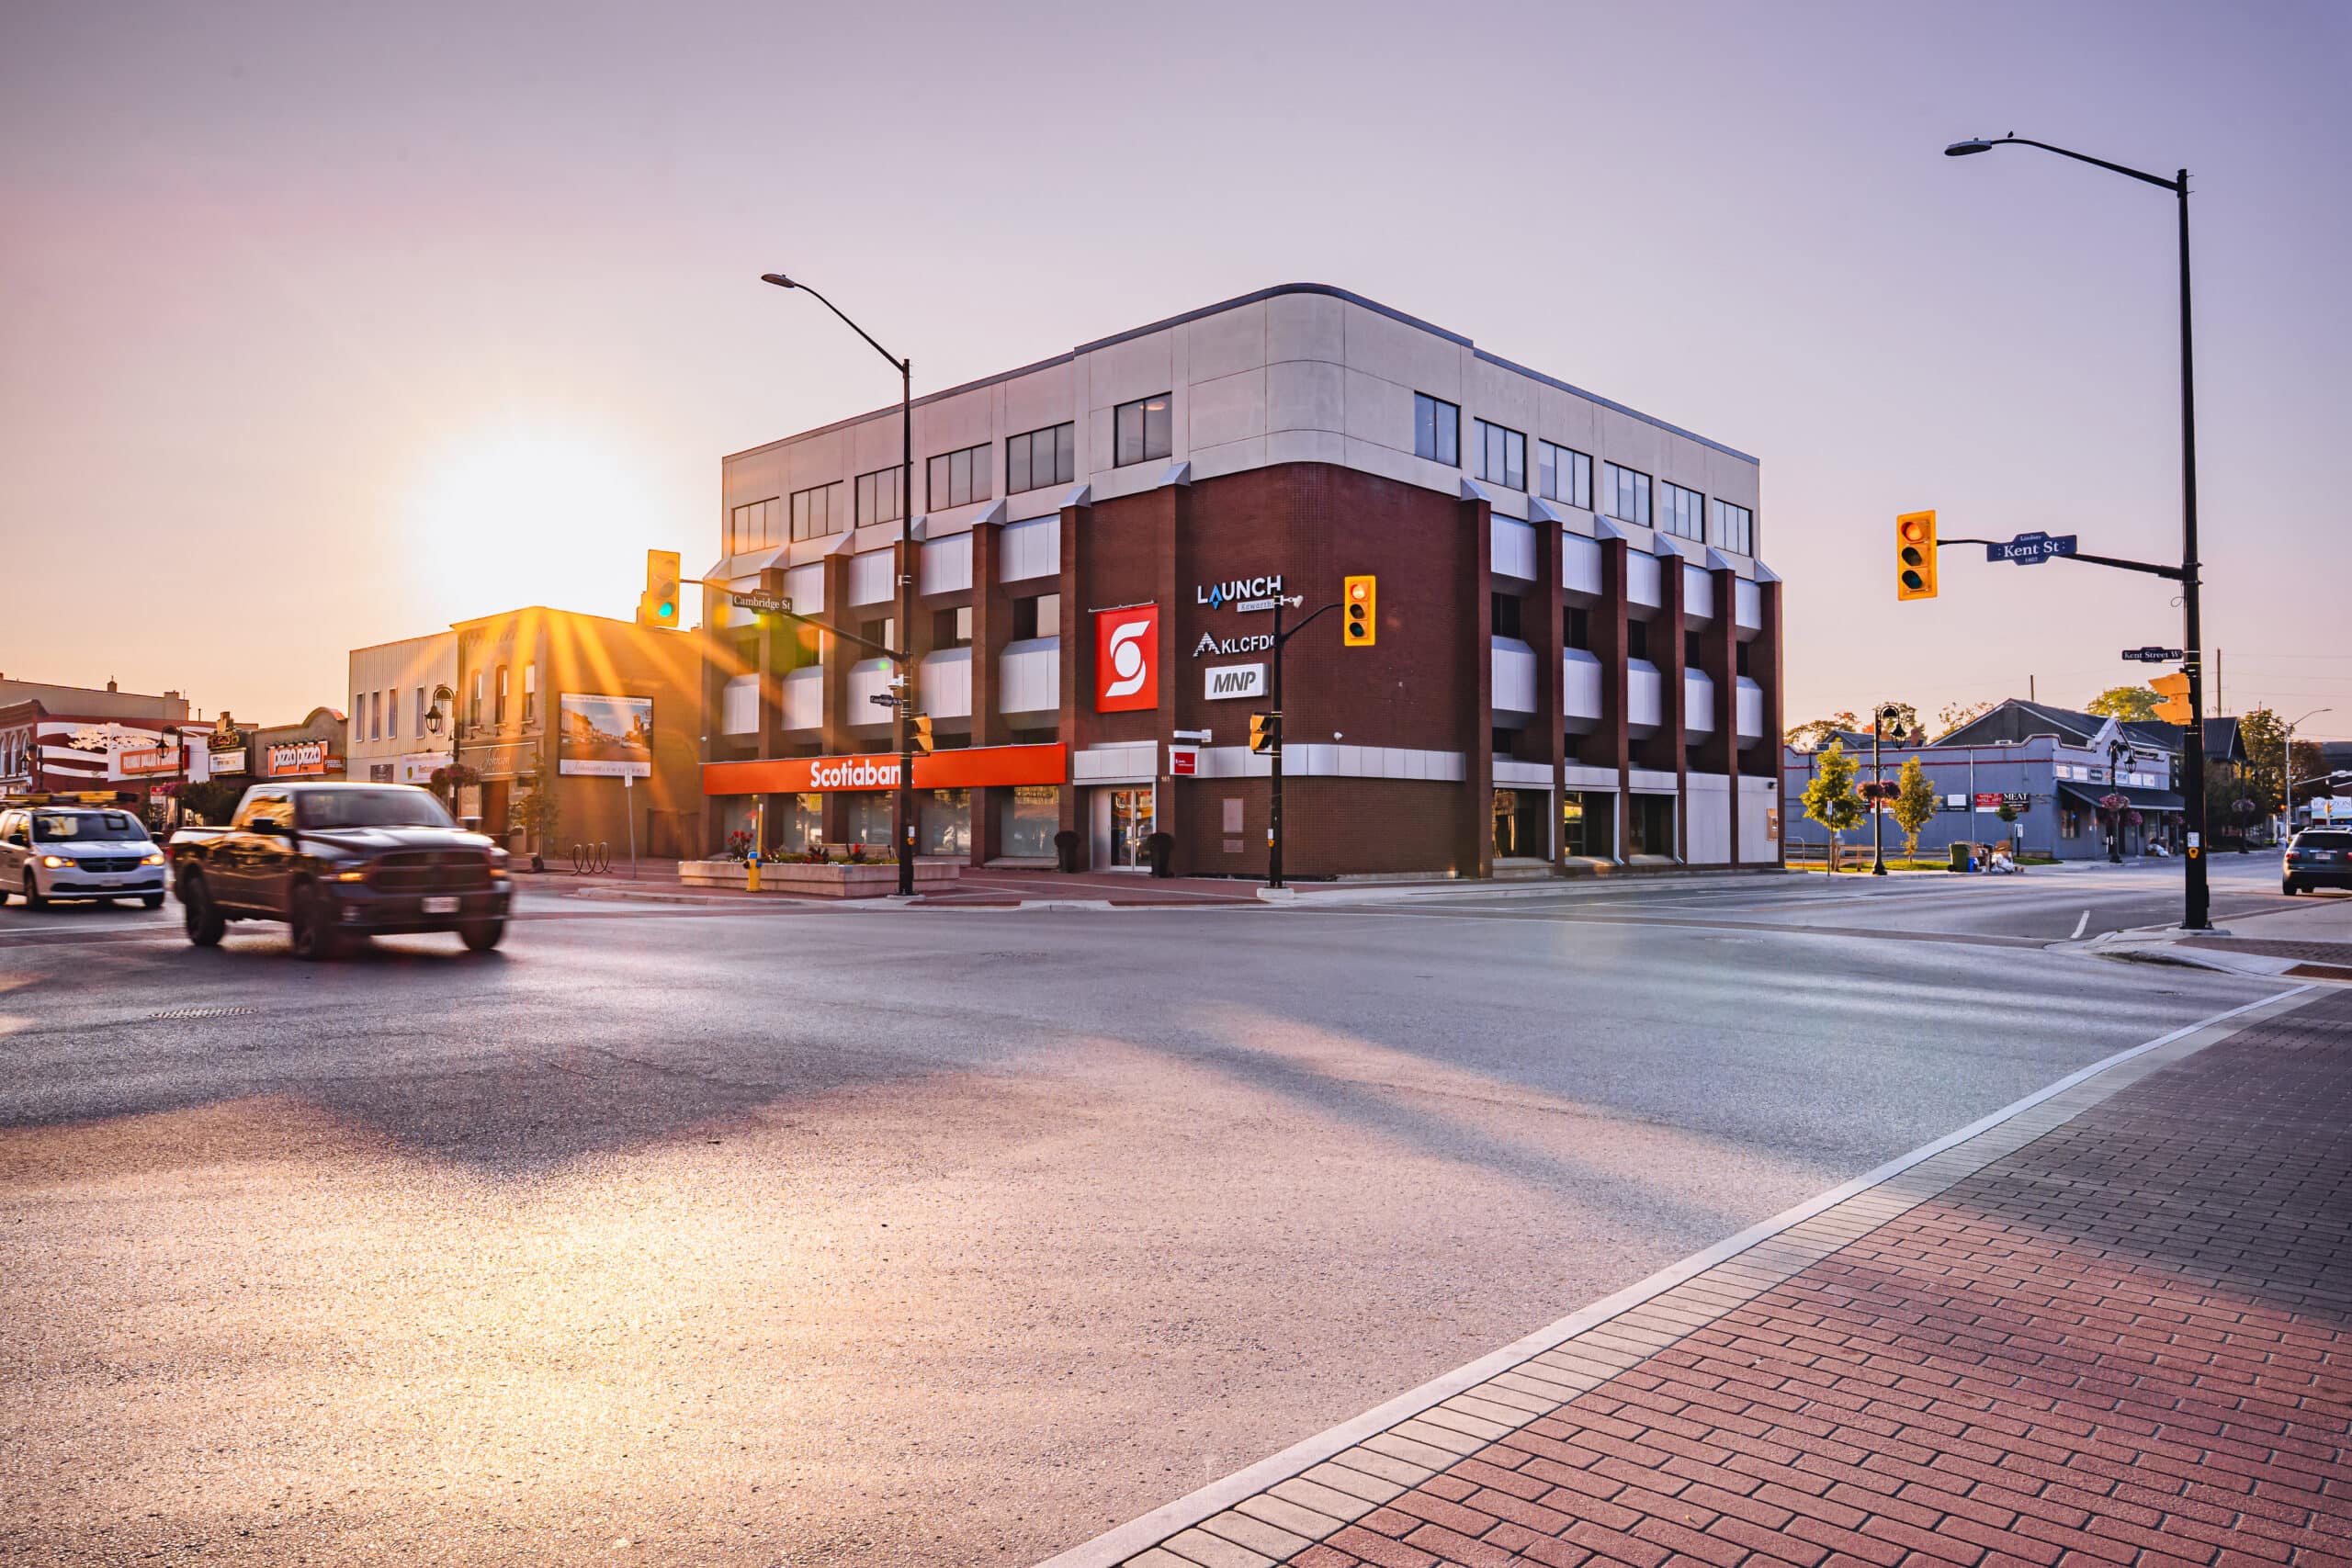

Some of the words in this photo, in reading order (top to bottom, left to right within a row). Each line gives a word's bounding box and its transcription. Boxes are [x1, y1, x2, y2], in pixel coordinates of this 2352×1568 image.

[2004, 545, 2040, 558] Kent
[2043, 541, 2059, 553] St
[1197, 575, 1282, 610] LAUNCH
[734, 595, 780, 611] Cambridge
[782, 599, 790, 610] St
[1241, 601, 1275, 611] Kawarth
[2124, 651, 2143, 660] Kent
[2144, 650, 2168, 659] Street
[1213, 671, 1256, 693] MNP
[273, 748, 296, 773] pizza
[297, 746, 321, 772] pizza
[810, 759, 915, 787] Scotiaban
